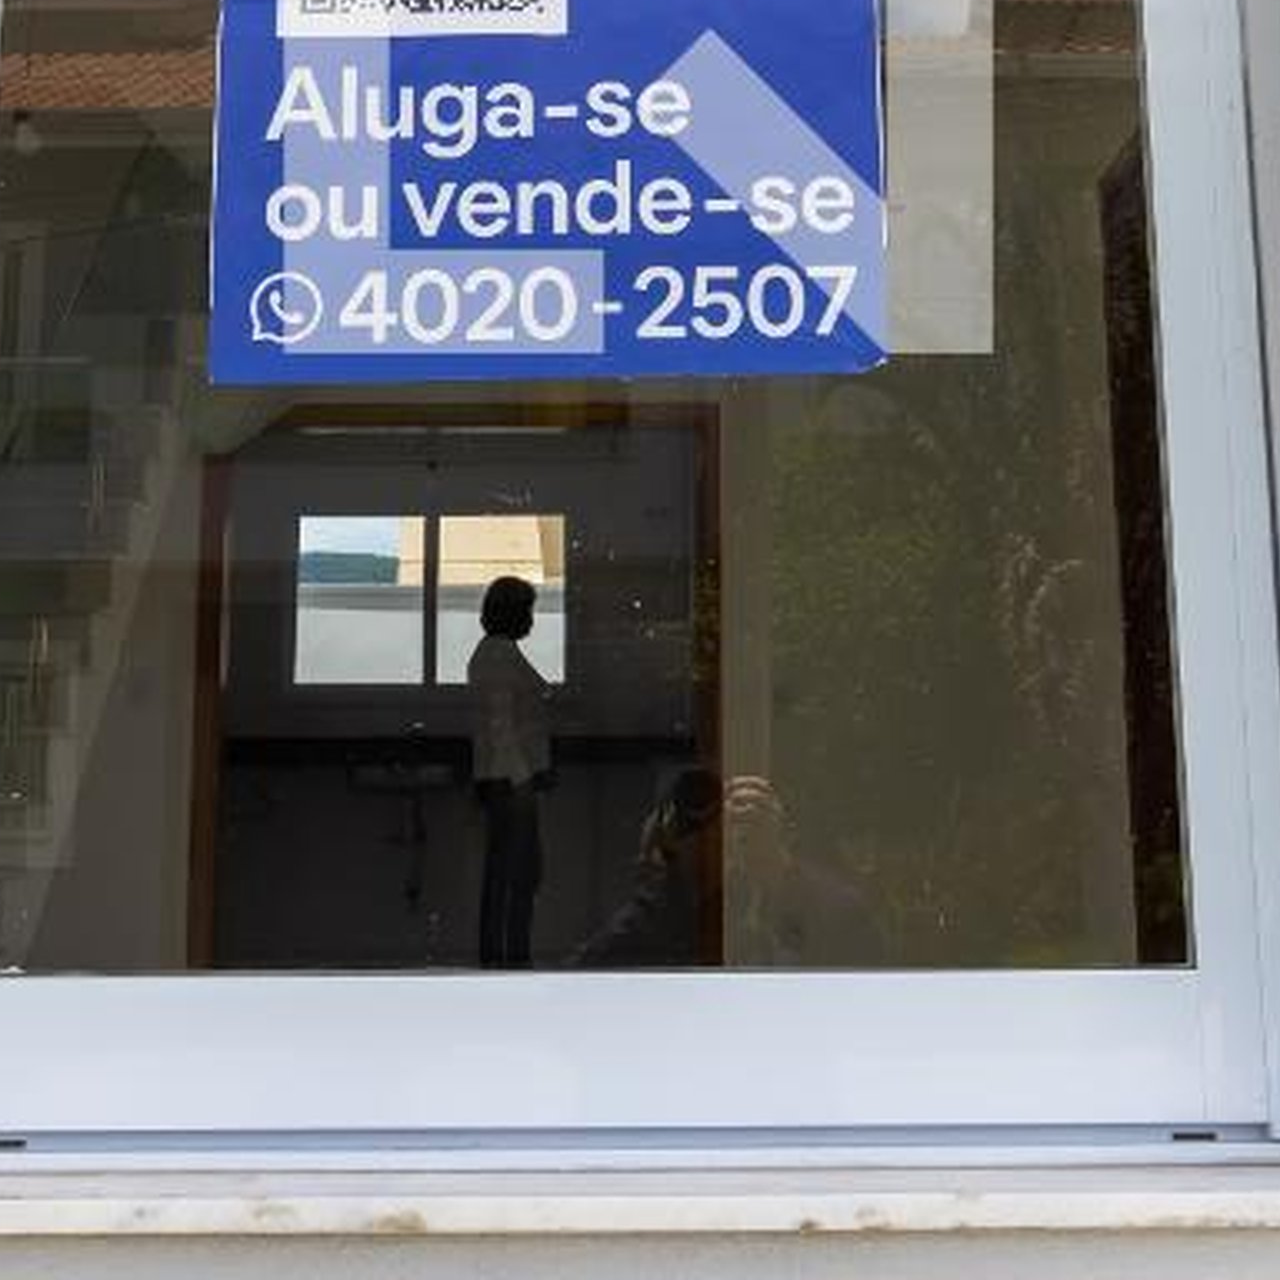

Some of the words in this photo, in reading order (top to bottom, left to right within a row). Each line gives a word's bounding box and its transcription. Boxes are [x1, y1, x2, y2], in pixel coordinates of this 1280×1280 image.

[266, 66, 691, 157] Aluga-se
[265, 182, 377, 241] ou
[403, 160, 854, 238] vende-se
[338, 265, 858, 344] 4020-2507
